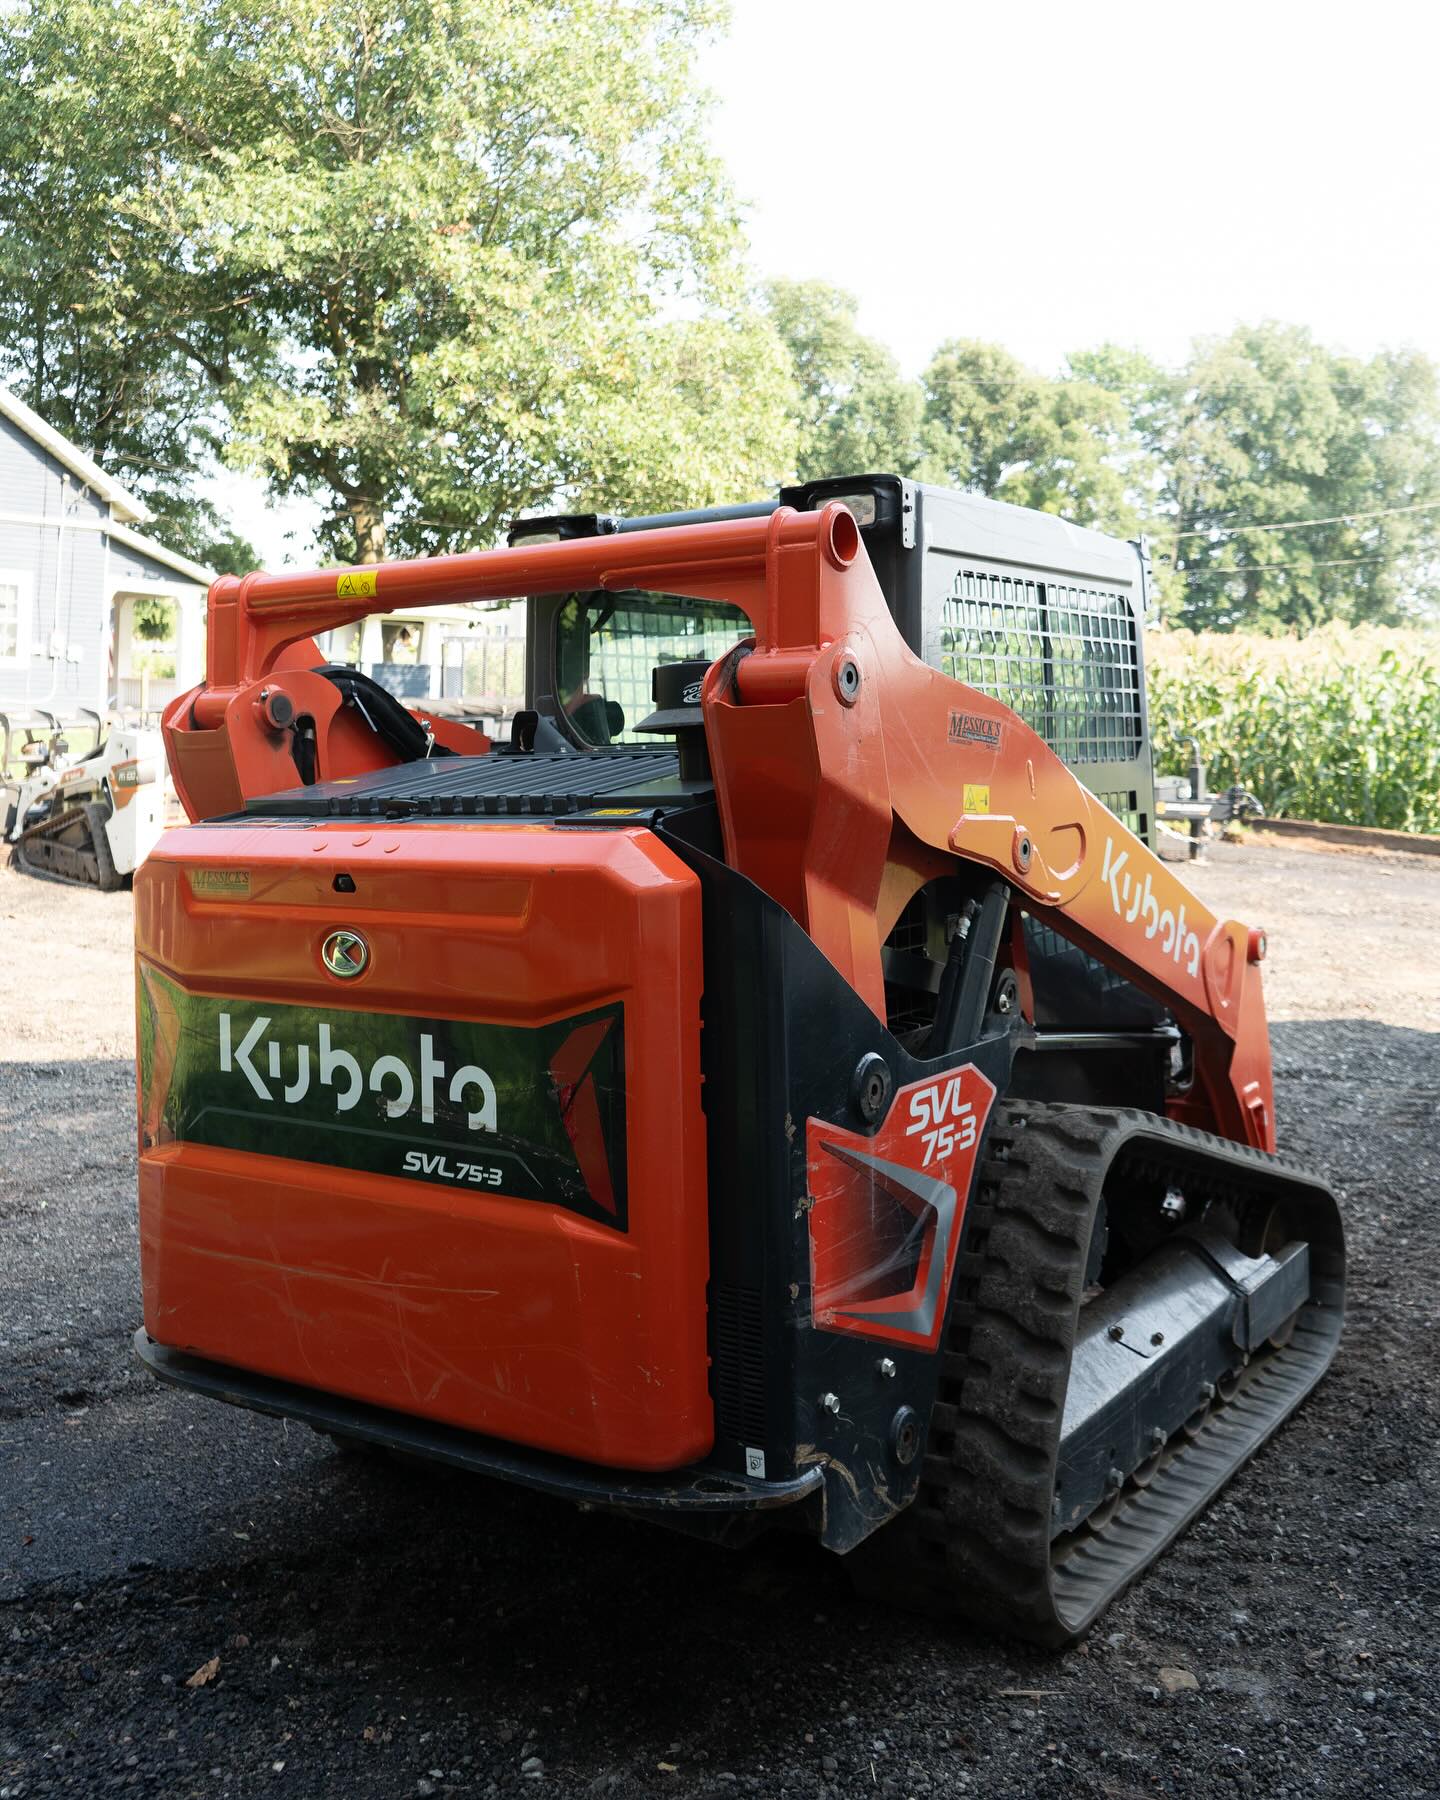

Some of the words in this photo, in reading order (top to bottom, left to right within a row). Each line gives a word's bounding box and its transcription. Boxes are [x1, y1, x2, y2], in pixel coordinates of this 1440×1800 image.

[949, 711, 1001, 737] MESSICK'S
[192, 871, 249, 888] MESSICK'S
[1101, 836, 1200, 978] Kubota
[219, 1012, 497, 1133] Kubota
[906, 1076, 972, 1136] SVL
[921, 1114, 977, 1168] 75-3
[402, 1151, 455, 1178] SVL
[456, 1162, 503, 1186] 75-3
